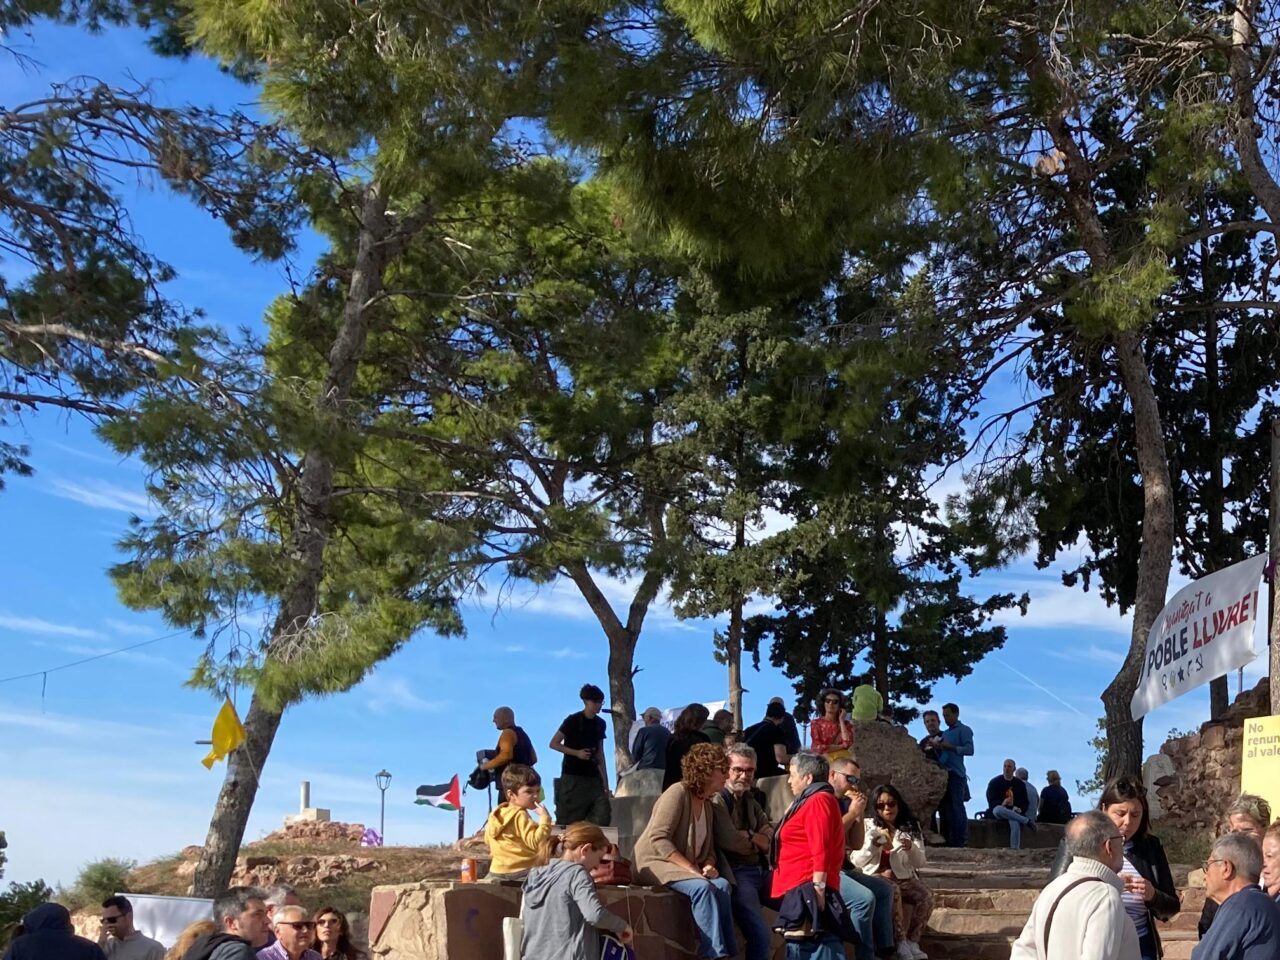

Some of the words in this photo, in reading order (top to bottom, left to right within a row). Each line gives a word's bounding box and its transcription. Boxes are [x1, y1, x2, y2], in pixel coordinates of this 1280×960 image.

[1147, 627, 1188, 677] POBLE
[1248, 723, 1264, 734] No
[1247, 746, 1257, 758] al
